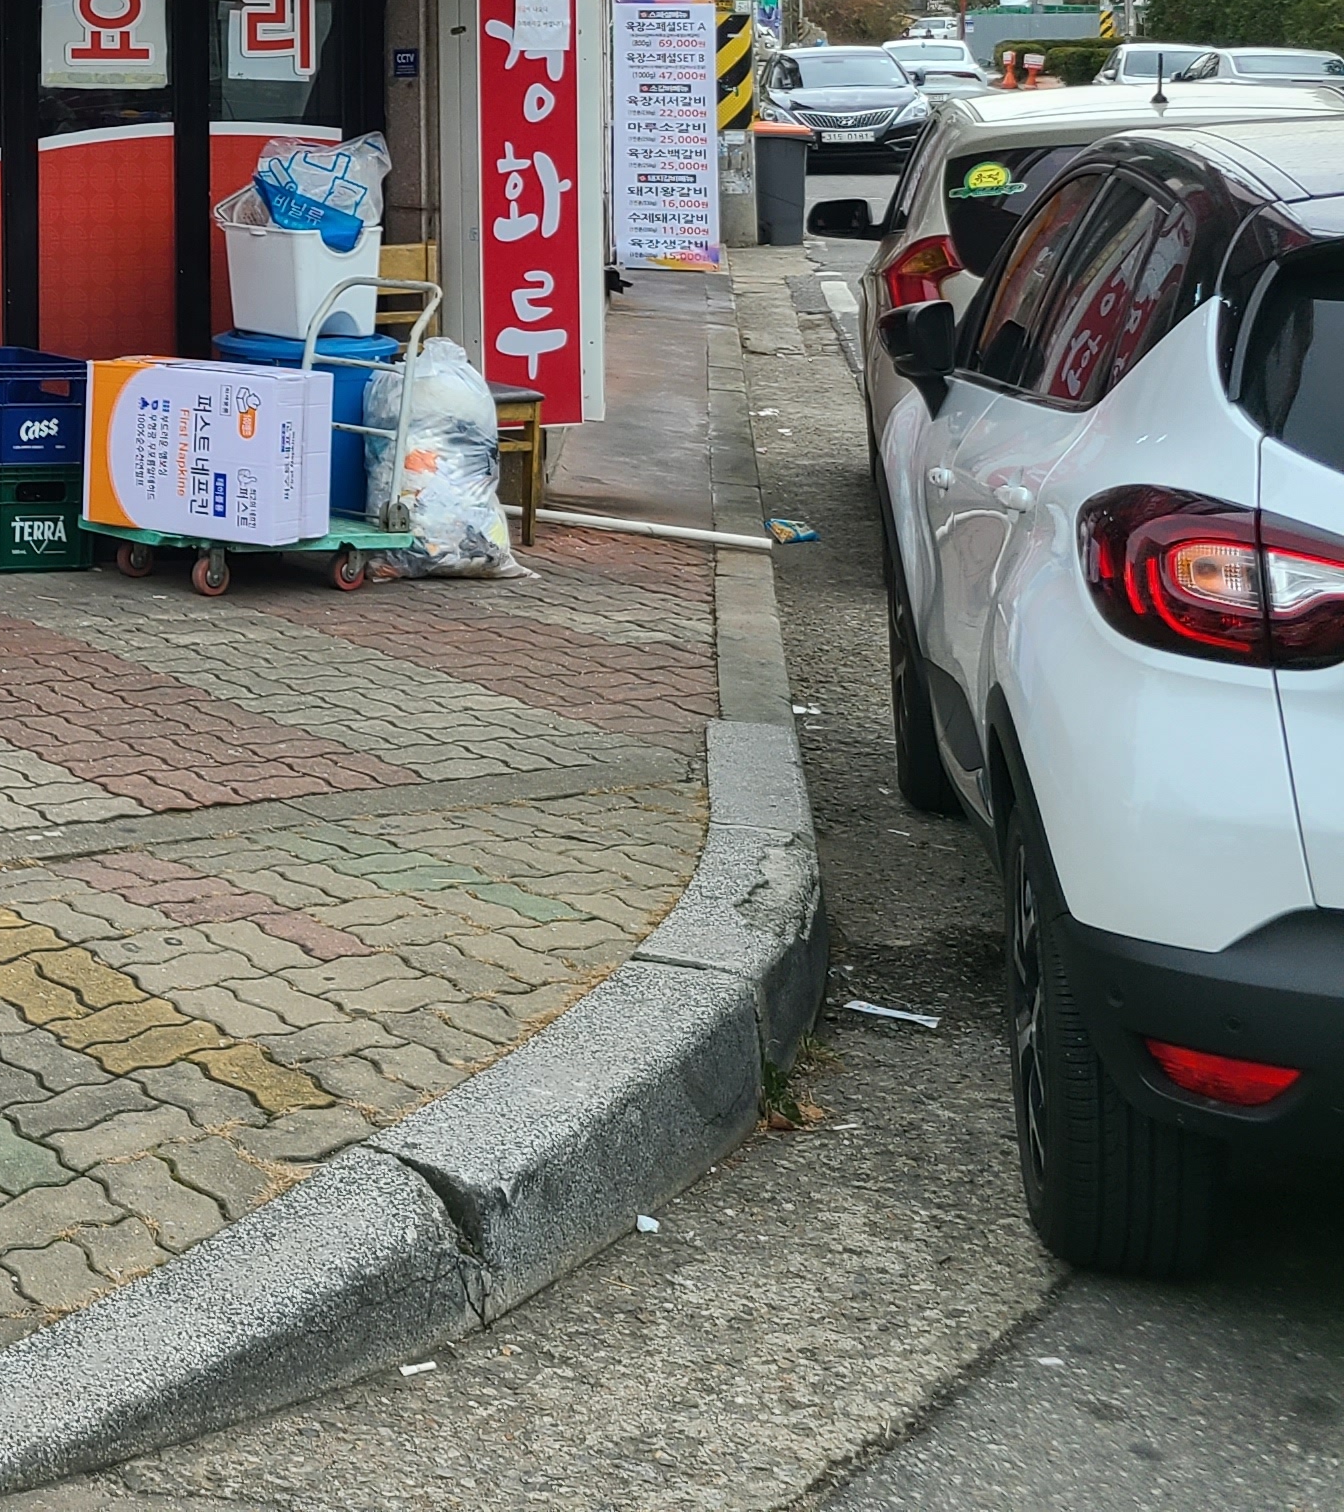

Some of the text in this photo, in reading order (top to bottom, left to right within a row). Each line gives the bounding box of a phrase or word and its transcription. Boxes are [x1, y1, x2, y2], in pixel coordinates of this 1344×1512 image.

[698, 22, 707, 31] A
[396, 53, 415, 64] CCTV
[699, 54, 705, 63] B
[626, 95, 706, 107] 육장서서갈비
[627, 122, 706, 133] 마루소갈비
[627, 148, 707, 159] 육장소백갈비
[627, 186, 708, 197] 돼지왕갈비
[274, 193, 325, 226] 비닐류
[627, 213, 708, 224] 수제돼지갈비
[628, 239, 709, 251] 육장생갈비
[178, 408, 190, 437] First
[189, 394, 212, 516] 퍼스트 네프킨
[235, 487, 249, 527] 퍼스트
[11, 515, 67, 543] TERRA
